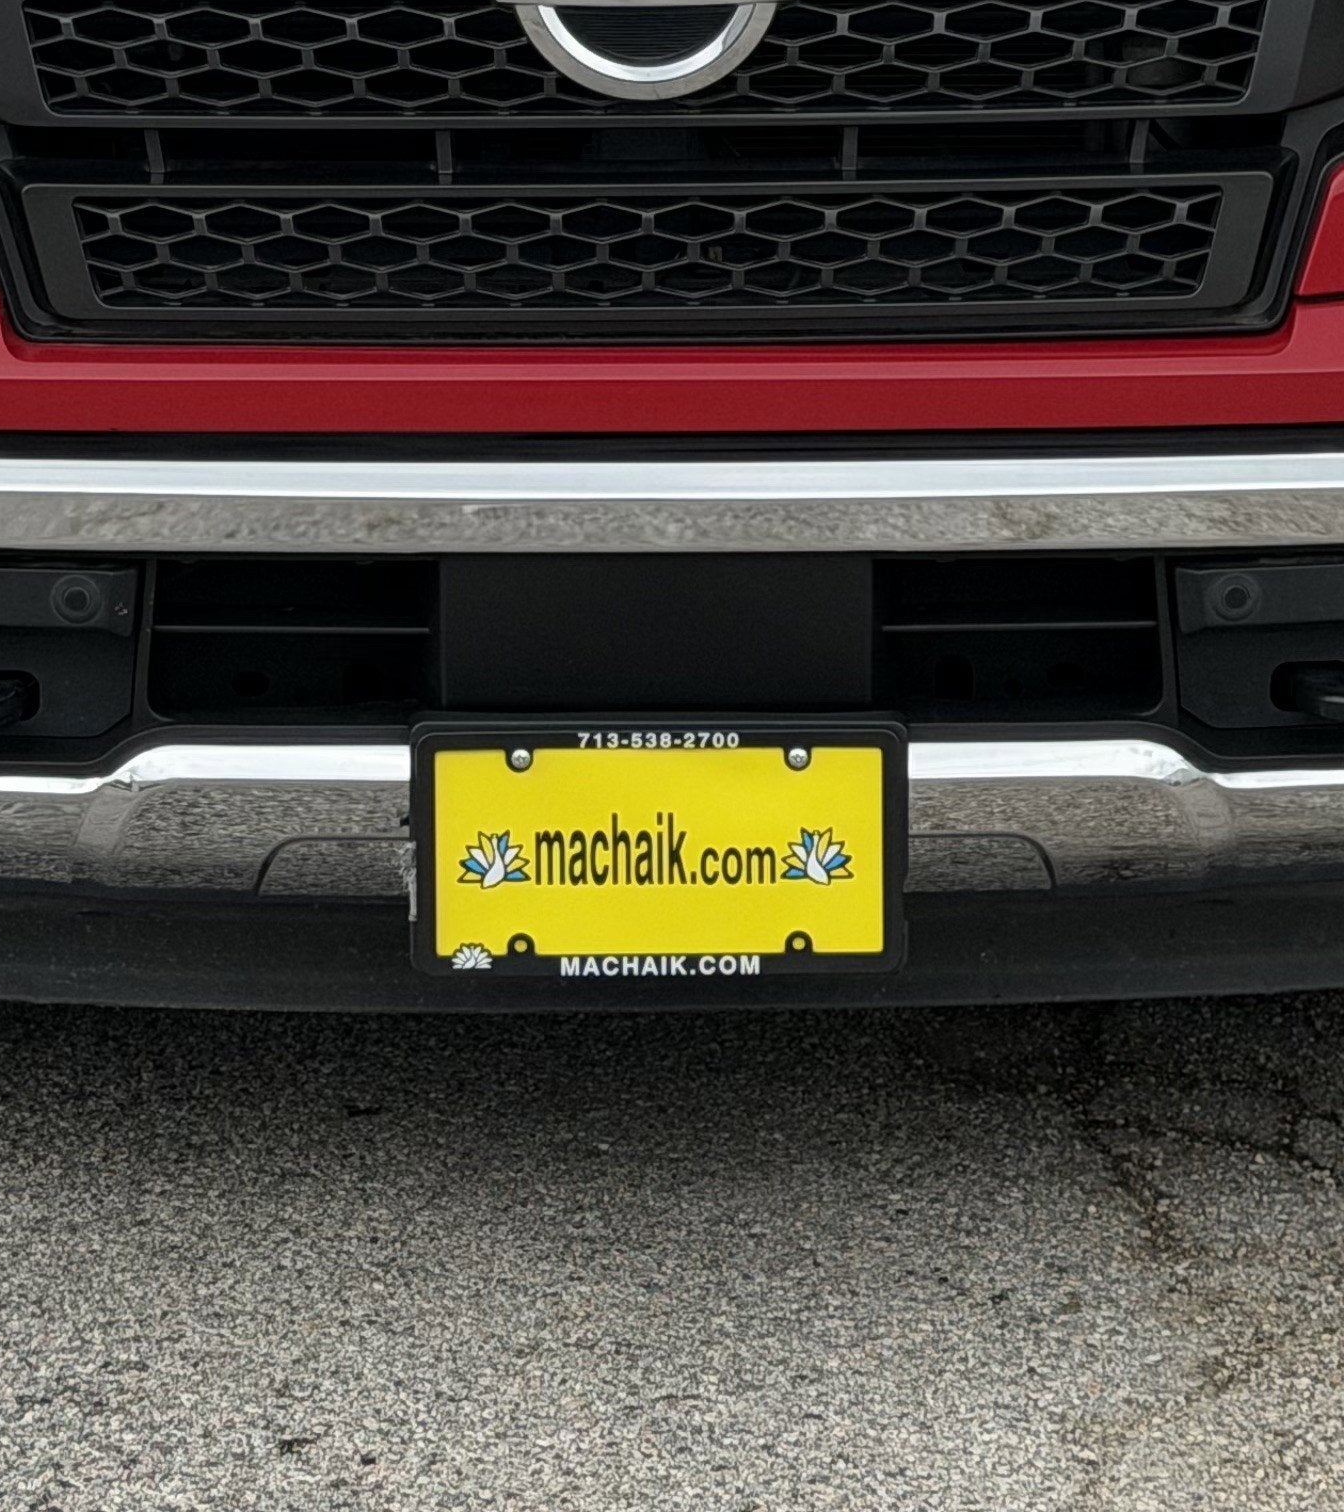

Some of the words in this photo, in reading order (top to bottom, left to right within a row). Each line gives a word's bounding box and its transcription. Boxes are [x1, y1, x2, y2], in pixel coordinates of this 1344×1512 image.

[578, 731, 740, 748] 713-538-2700
[535, 811, 776, 886] machaik.com
[560, 955, 761, 977] MACHAIK.COM
